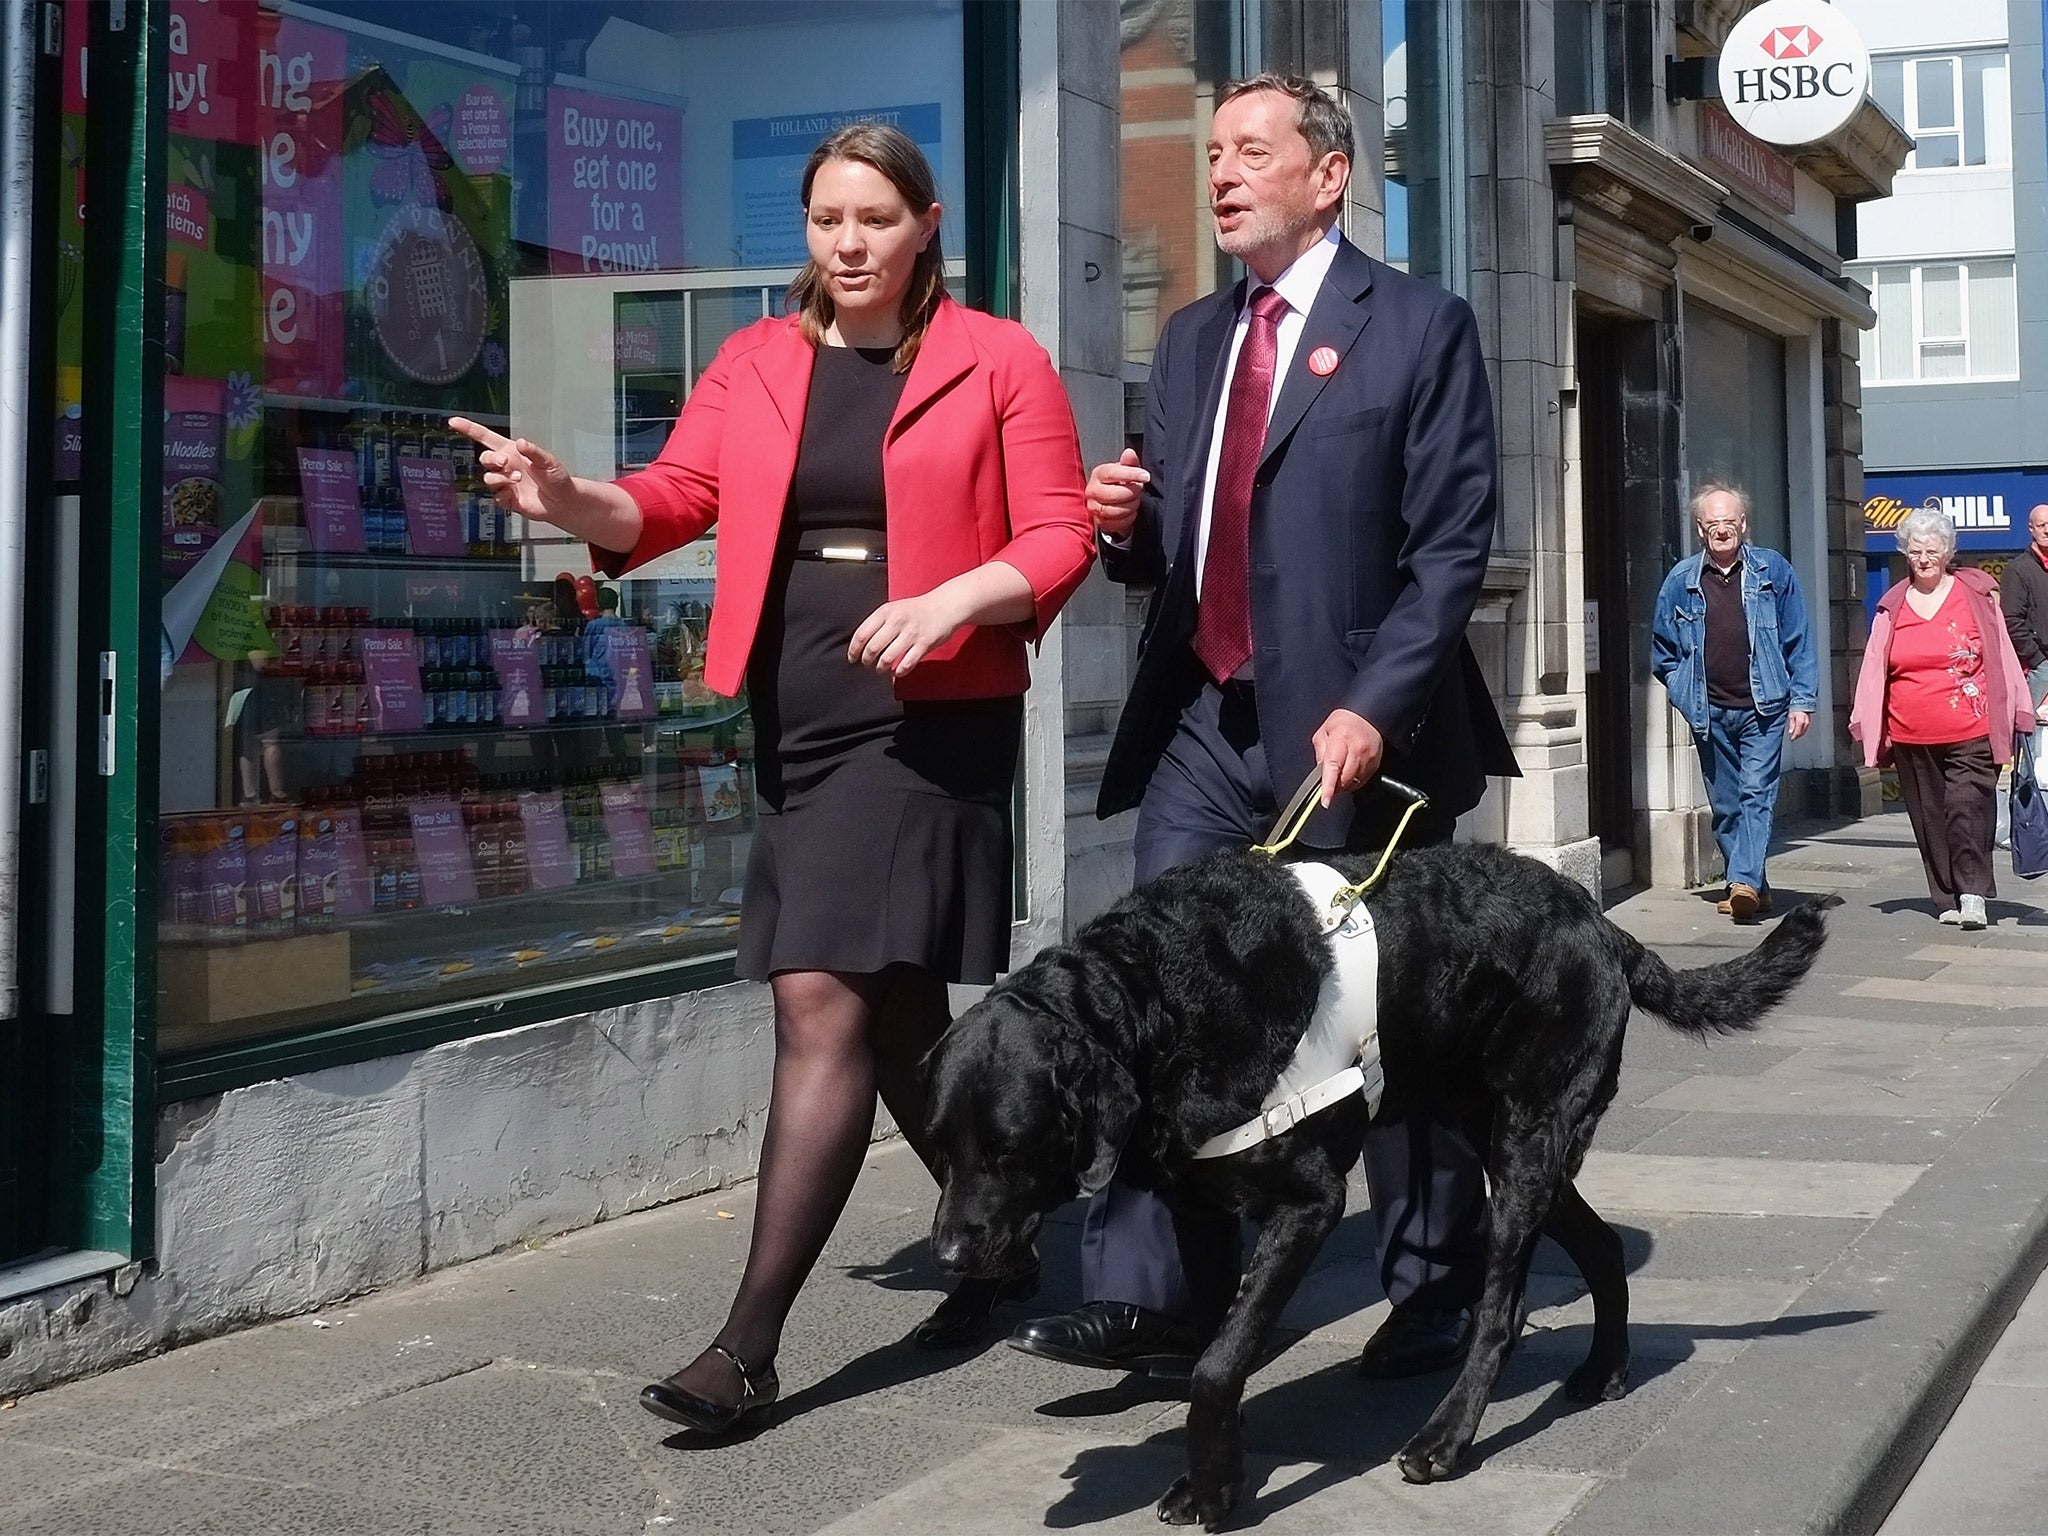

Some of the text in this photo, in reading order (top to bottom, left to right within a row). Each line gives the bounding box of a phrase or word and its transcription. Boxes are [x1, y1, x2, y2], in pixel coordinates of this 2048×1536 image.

[1734, 62, 1855, 104] HSBC
[564, 107, 662, 153] Buy one,
[770, 118, 828, 137] HOLLAND
[573, 154, 657, 191] get one
[591, 192, 644, 231] for a
[582, 235, 660, 272] Penny!
[171, 440, 217, 458] Noodles
[302, 457, 343, 472] Penny Sale
[402, 465, 442, 479] Penny Sale
[1942, 495, 2011, 527] HILL
[364, 638, 403, 650] Penny Sale
[493, 638, 511, 649] Penny
[607, 635, 638, 646] Penny Sale
[604, 793, 621, 806] Penny
[521, 802, 539, 814] Penny
[413, 811, 451, 826] Penny Sale
